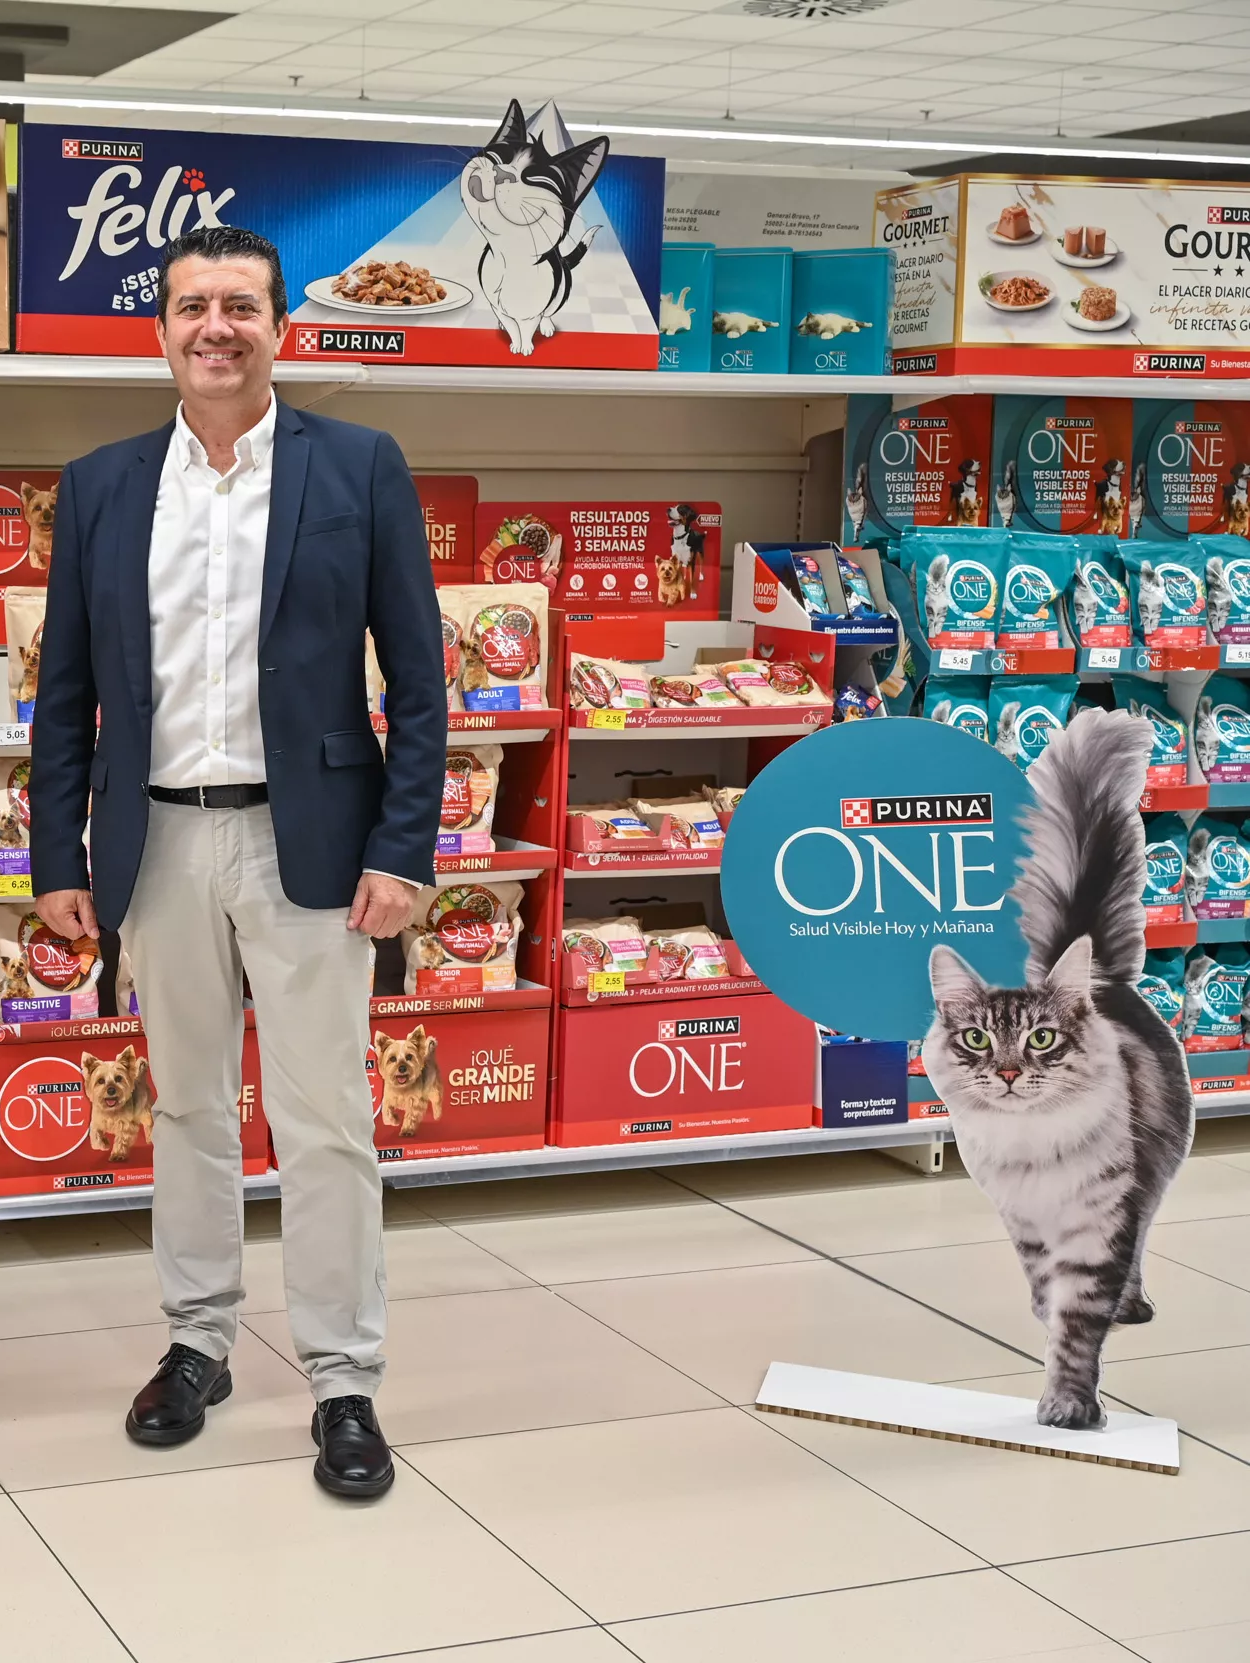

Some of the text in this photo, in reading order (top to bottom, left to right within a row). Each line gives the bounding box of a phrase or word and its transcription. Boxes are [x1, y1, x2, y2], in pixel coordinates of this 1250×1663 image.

[82, 144, 137, 157] PURINA
[666, 207, 721, 216] MESA PLEGABLE
[767, 212, 791, 220] General
[908, 207, 931, 217] PURINA
[59, 165, 235, 281] felix
[883, 215, 949, 242] GOURMET
[122, 267, 159, 293] ¡SER
[1158, 285, 1211, 298] EL PLACER
[112, 294, 135, 311] ES
[901, 309, 930, 321] RECETAS
[894, 321, 928, 335] GOURMET
[1174, 319, 1236, 331] DE RECETAS
[322, 333, 399, 350] PURINA
[896, 357, 935, 373] PURINA
[1151, 357, 1202, 370] PURINA
[910, 420, 946, 428] PURINA
[880, 431, 951, 465] ONE
[885, 472, 944, 481] RESULTADOS
[886, 483, 942, 492] VISIBLES EN
[887, 494, 940, 503] 3 SEMANAS
[570, 510, 650, 524] RESULTADOS
[573, 525, 647, 538] VISIBLES EN
[574, 540, 646, 552] 3 SEMANAS
[612, 562, 645, 570] INTESTINAL
[754, 583, 778, 595] 100%
[953, 581, 988, 599] ONE
[953, 657, 969, 665] 5,45
[478, 690, 503, 699] ADULT
[606, 715, 621, 723] 2,55
[648, 714, 721, 724] DIGESTIÓN SALUDABLE
[7, 730, 26, 740] 5,05
[876, 799, 984, 820] PURINA
[602, 854, 630, 862] SEMANA
[642, 852, 669, 861] ENERGÍA
[676, 852, 708, 860] VITALIDAD
[774, 826, 1006, 916] ONE
[789, 920, 994, 938] Salud Visible Hoy y Mañana
[435, 969, 460, 978] SENIOR
[601, 989, 629, 997] SEMANA
[640, 987, 664, 996] PELAJE
[665, 985, 696, 995] RADIANTE
[702, 983, 719, 992] OJOS
[720, 980, 762, 991] RELUCIENTES
[11, 999, 60, 1010] SENSITIVE
[51, 1020, 139, 1038] ¡QUÉ GRANDE
[678, 1020, 732, 1036] PURINA
[472, 1045, 514, 1066] ¡QUÉ
[449, 1064, 536, 1087] GRANDE
[630, 1042, 745, 1098] ONE
[39, 1083, 81, 1094] PURINA
[1202, 1081, 1234, 1090] PURINA
[450, 1083, 533, 1106] SER MINI!
[841, 1099, 862, 1110] Forma
[869, 1097, 897, 1108] textura
[5, 1095, 85, 1131] ONE
[843, 1107, 894, 1119] sorprendentes
[632, 1122, 669, 1133] PURINA
[712, 1118, 731, 1126] Nuestra
[66, 1175, 113, 1187] PURINA
